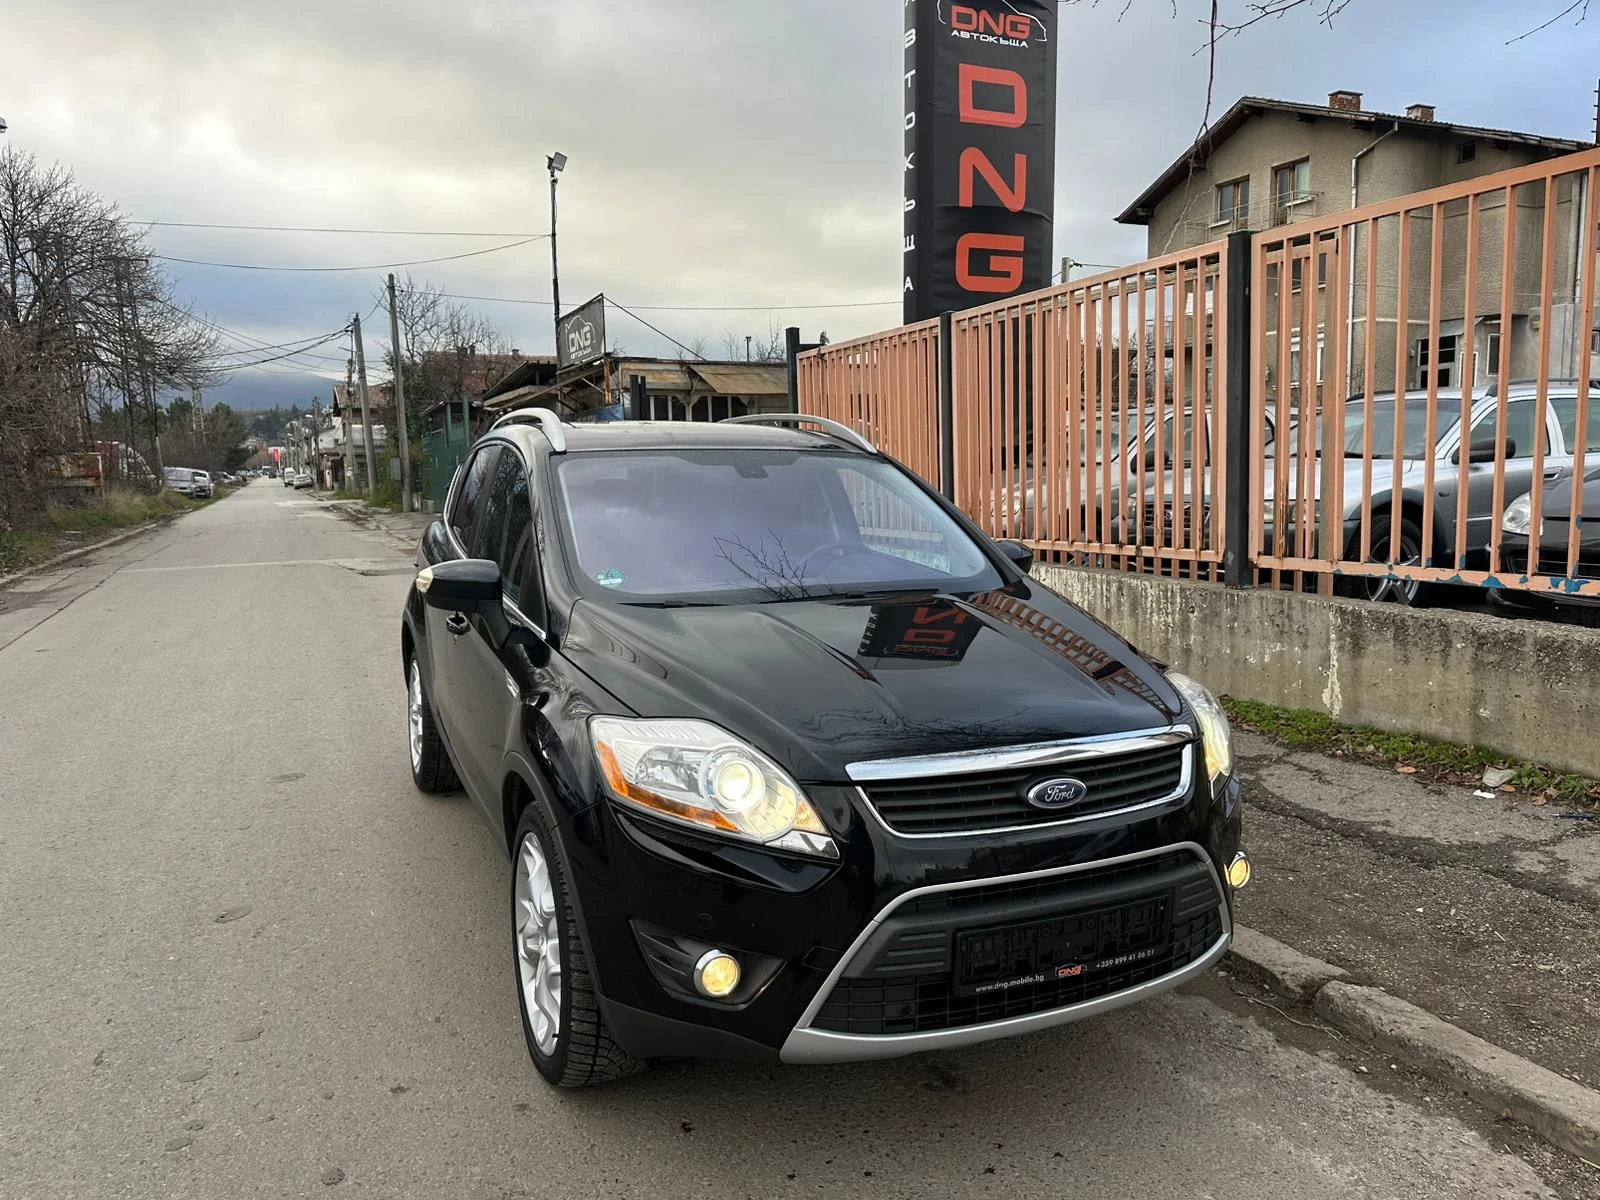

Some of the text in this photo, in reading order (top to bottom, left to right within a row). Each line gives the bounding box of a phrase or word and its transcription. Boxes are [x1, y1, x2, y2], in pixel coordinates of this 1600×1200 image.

[952, 5, 1031, 39] DNG
[955, 63, 1028, 293] DNG
[568, 325, 591, 353] DNG
[1044, 784, 1075, 802] Ford
[975, 974, 1045, 993] www.dng.mobile.bg
[1095, 959, 1114, 968] +359
